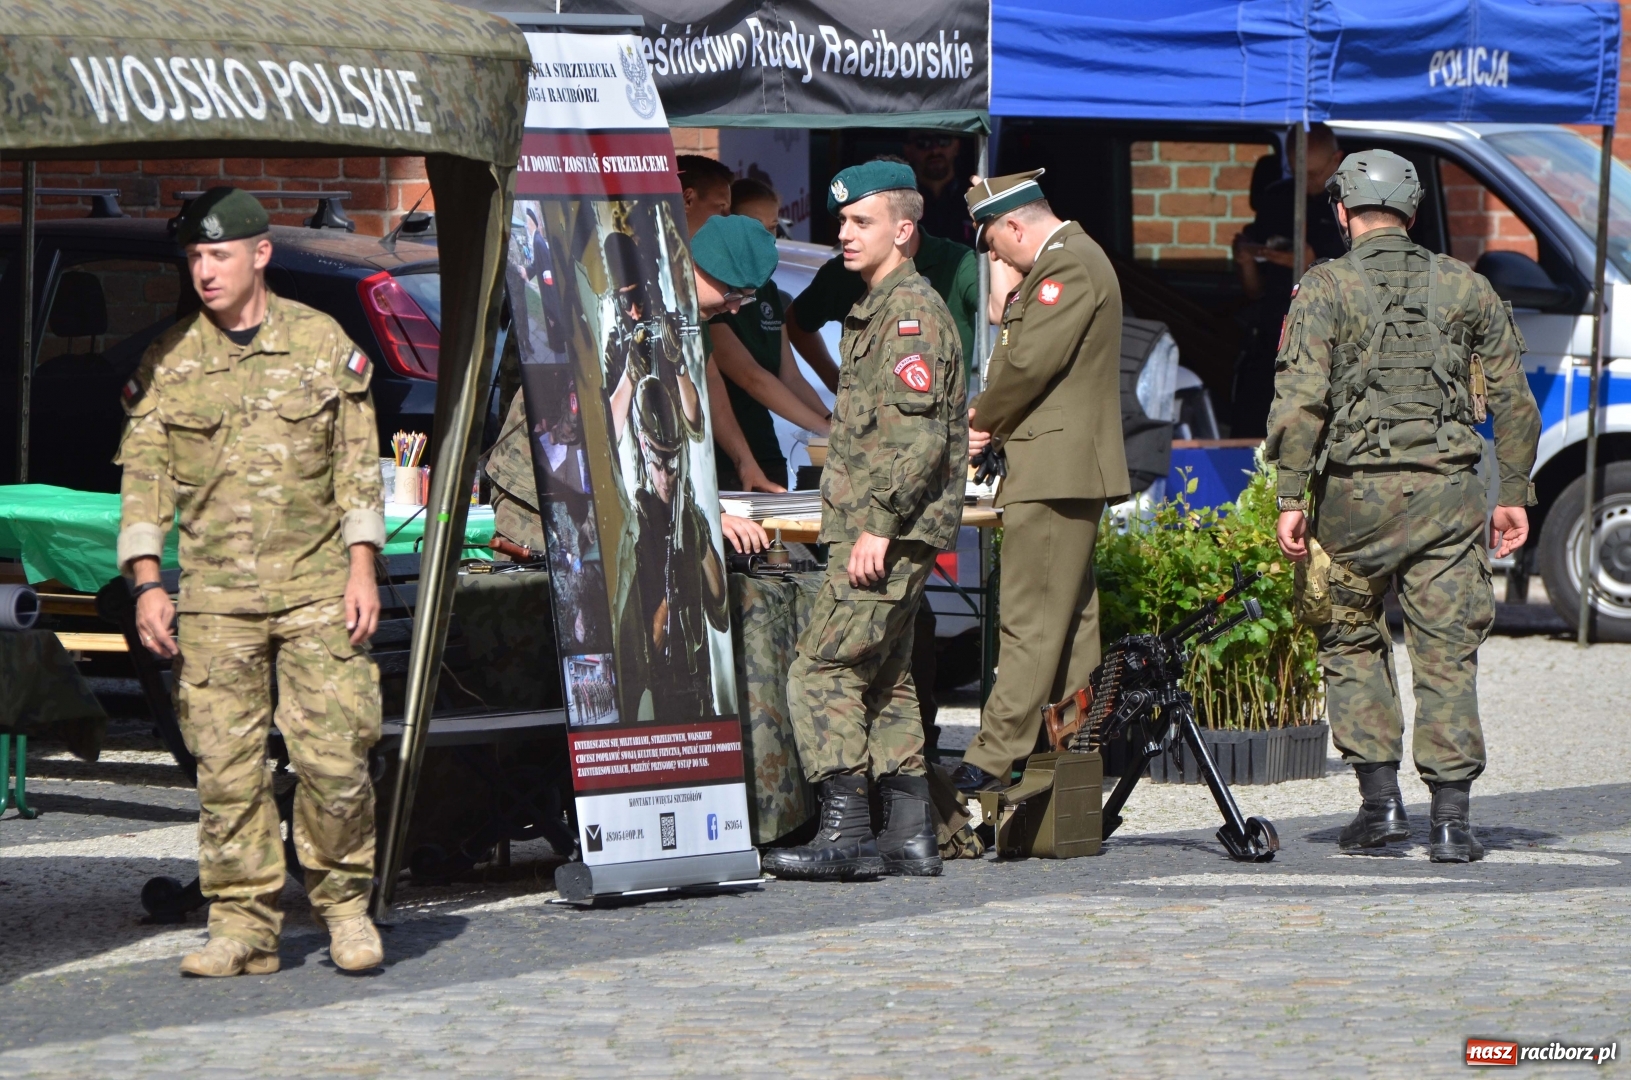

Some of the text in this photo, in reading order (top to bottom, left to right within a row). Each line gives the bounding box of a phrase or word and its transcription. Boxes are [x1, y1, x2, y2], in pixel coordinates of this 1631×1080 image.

[746, 17, 815, 83] Rudy
[818, 24, 974, 80] Raciborskie
[553, 63, 617, 78] STRZELECKA
[1428, 46, 1509, 88] POLICJA
[70, 54, 432, 134] WOJSKO POLSKIE
[547, 84, 600, 103] RACIBÓRZ
[521, 155, 531, 172] Z
[530, 155, 562, 173] DOMU!
[562, 153, 600, 173] ZOSTAŃ
[602, 155, 669, 173] STRZELCEM!
[628, 796, 652, 807] KONTAKT
[655, 794, 673, 806] WIĘCEJ
